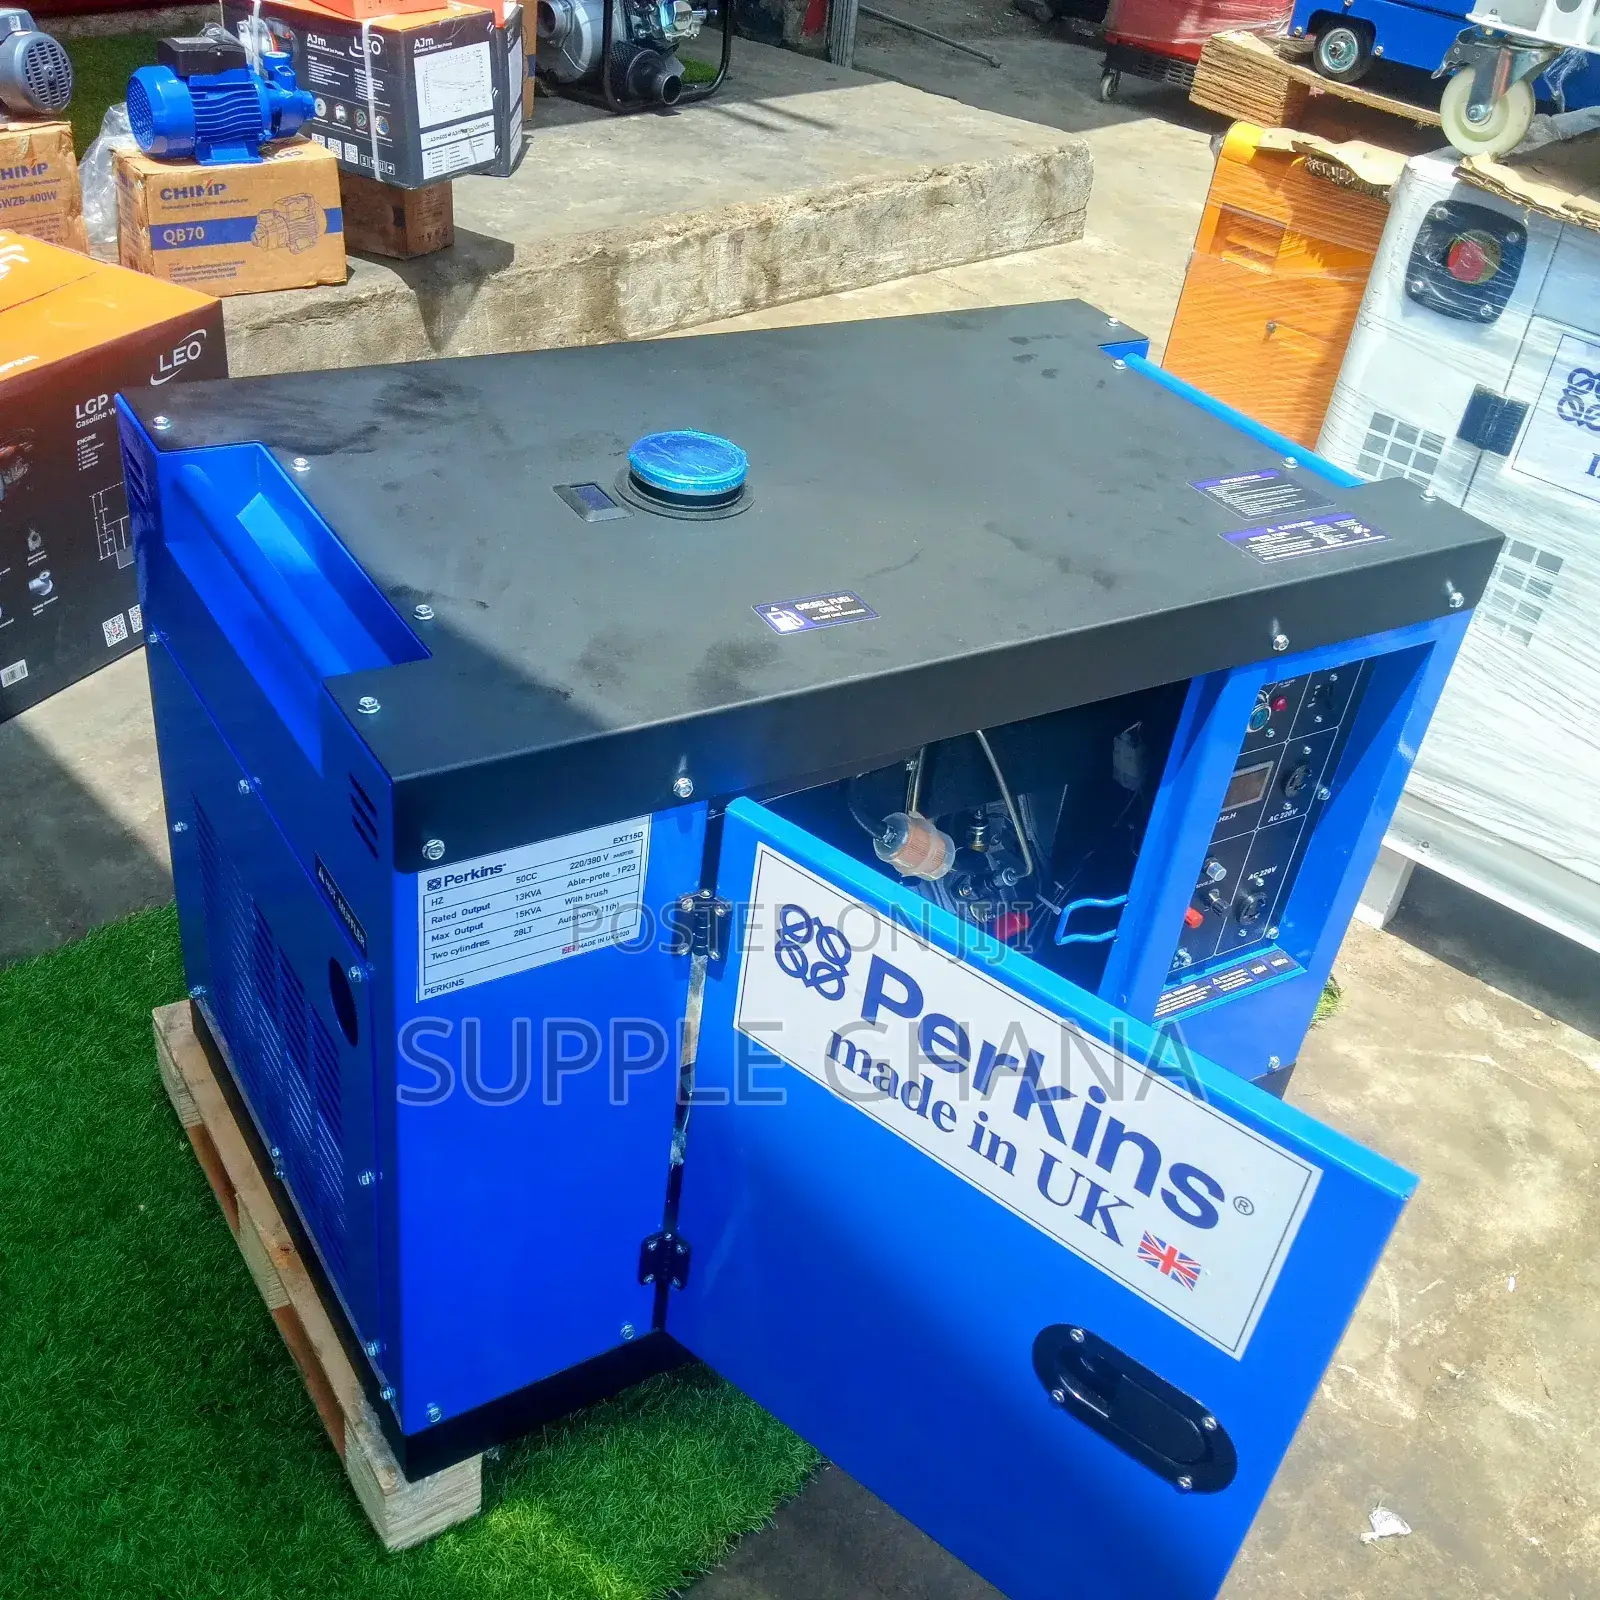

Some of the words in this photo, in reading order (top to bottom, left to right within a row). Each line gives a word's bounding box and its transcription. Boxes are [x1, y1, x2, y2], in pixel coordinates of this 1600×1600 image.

[306, 33, 327, 47] AJm
[414, 38, 434, 49] AJm
[0, 162, 48, 180] HIMP
[160, 181, 227, 201] CHIMP
[163, 226, 205, 246] QB70
[159, 341, 201, 373] LEO
[75, 393, 109, 420] LGP
[75, 411, 108, 429] Gasoline
[108, 407, 117, 416] W
[1268, 813, 1280, 823] AC
[1280, 808, 1298, 819] 220V
[613, 831, 644, 844] EXT15D
[431, 896, 444, 907] HZ
[515, 872, 538, 884] 50CC
[569, 855, 602, 870] 220/380
[602, 853, 610, 861] V
[444, 865, 503, 887] Perkins
[1248, 872, 1260, 881] AC
[1259, 866, 1278, 877] 220V
[431, 911, 457, 925] Rated
[461, 902, 491, 917] Output
[515, 888, 542, 902] 13KVA
[567, 870, 610, 888] Able-prote
[431, 931, 450, 943] Max
[454, 922, 484, 936] Output
[515, 906, 542, 919] 15KVA
[564, 896, 583, 906] With
[585, 888, 609, 900] brush
[430, 950, 449, 961] Two
[450, 939, 491, 956] cylindres
[513, 925, 534, 938] 28LT
[557, 908, 599, 925] Autonomy
[601, 902, 620, 913] 11(h)
[579, 939, 597, 949] MADE
[424, 978, 465, 996] PERKINS
[860, 955, 1226, 1231] Perkins
[826, 1030, 957, 1135] made
[966, 1109, 1020, 1177] in
[1036, 1147, 1135, 1248] UK
